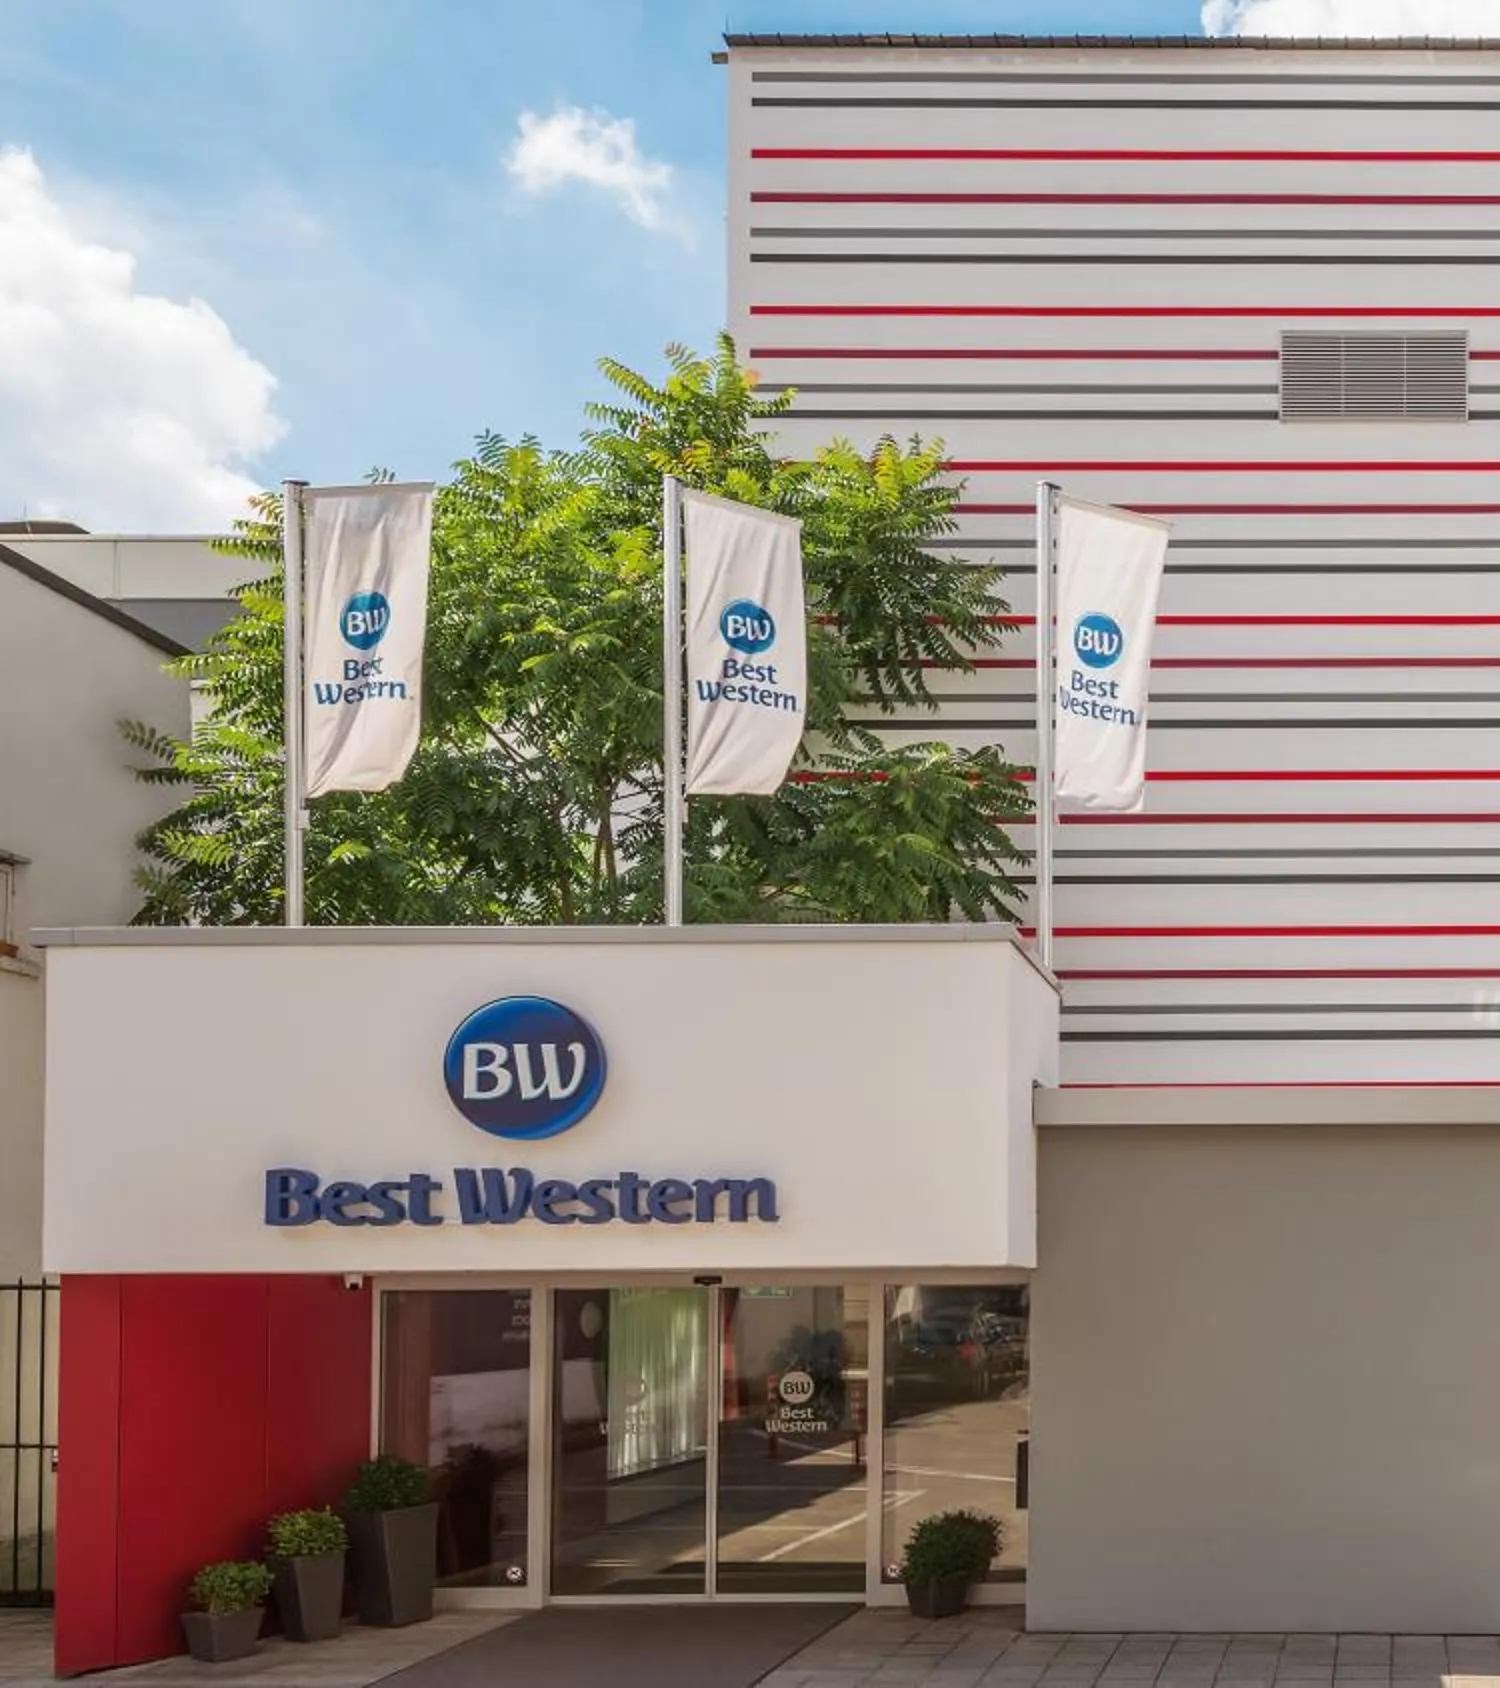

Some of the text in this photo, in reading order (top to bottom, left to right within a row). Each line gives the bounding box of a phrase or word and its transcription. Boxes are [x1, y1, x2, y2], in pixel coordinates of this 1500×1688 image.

[347, 607, 387, 636] BW
[726, 615, 771, 641] BW
[1078, 625, 1119, 655] BW
[343, 656, 383, 681] Bet
[722, 657, 778, 685] Best
[314, 680, 407, 705] Wesrn
[1071, 669, 1119, 699] Best
[462, 1041, 586, 1101] BW
[264, 1167, 780, 1227] Best Western
[783, 1381, 812, 1395] BW
[765, 1419, 828, 1433] Western
[781, 1407, 815, 1420] Best
